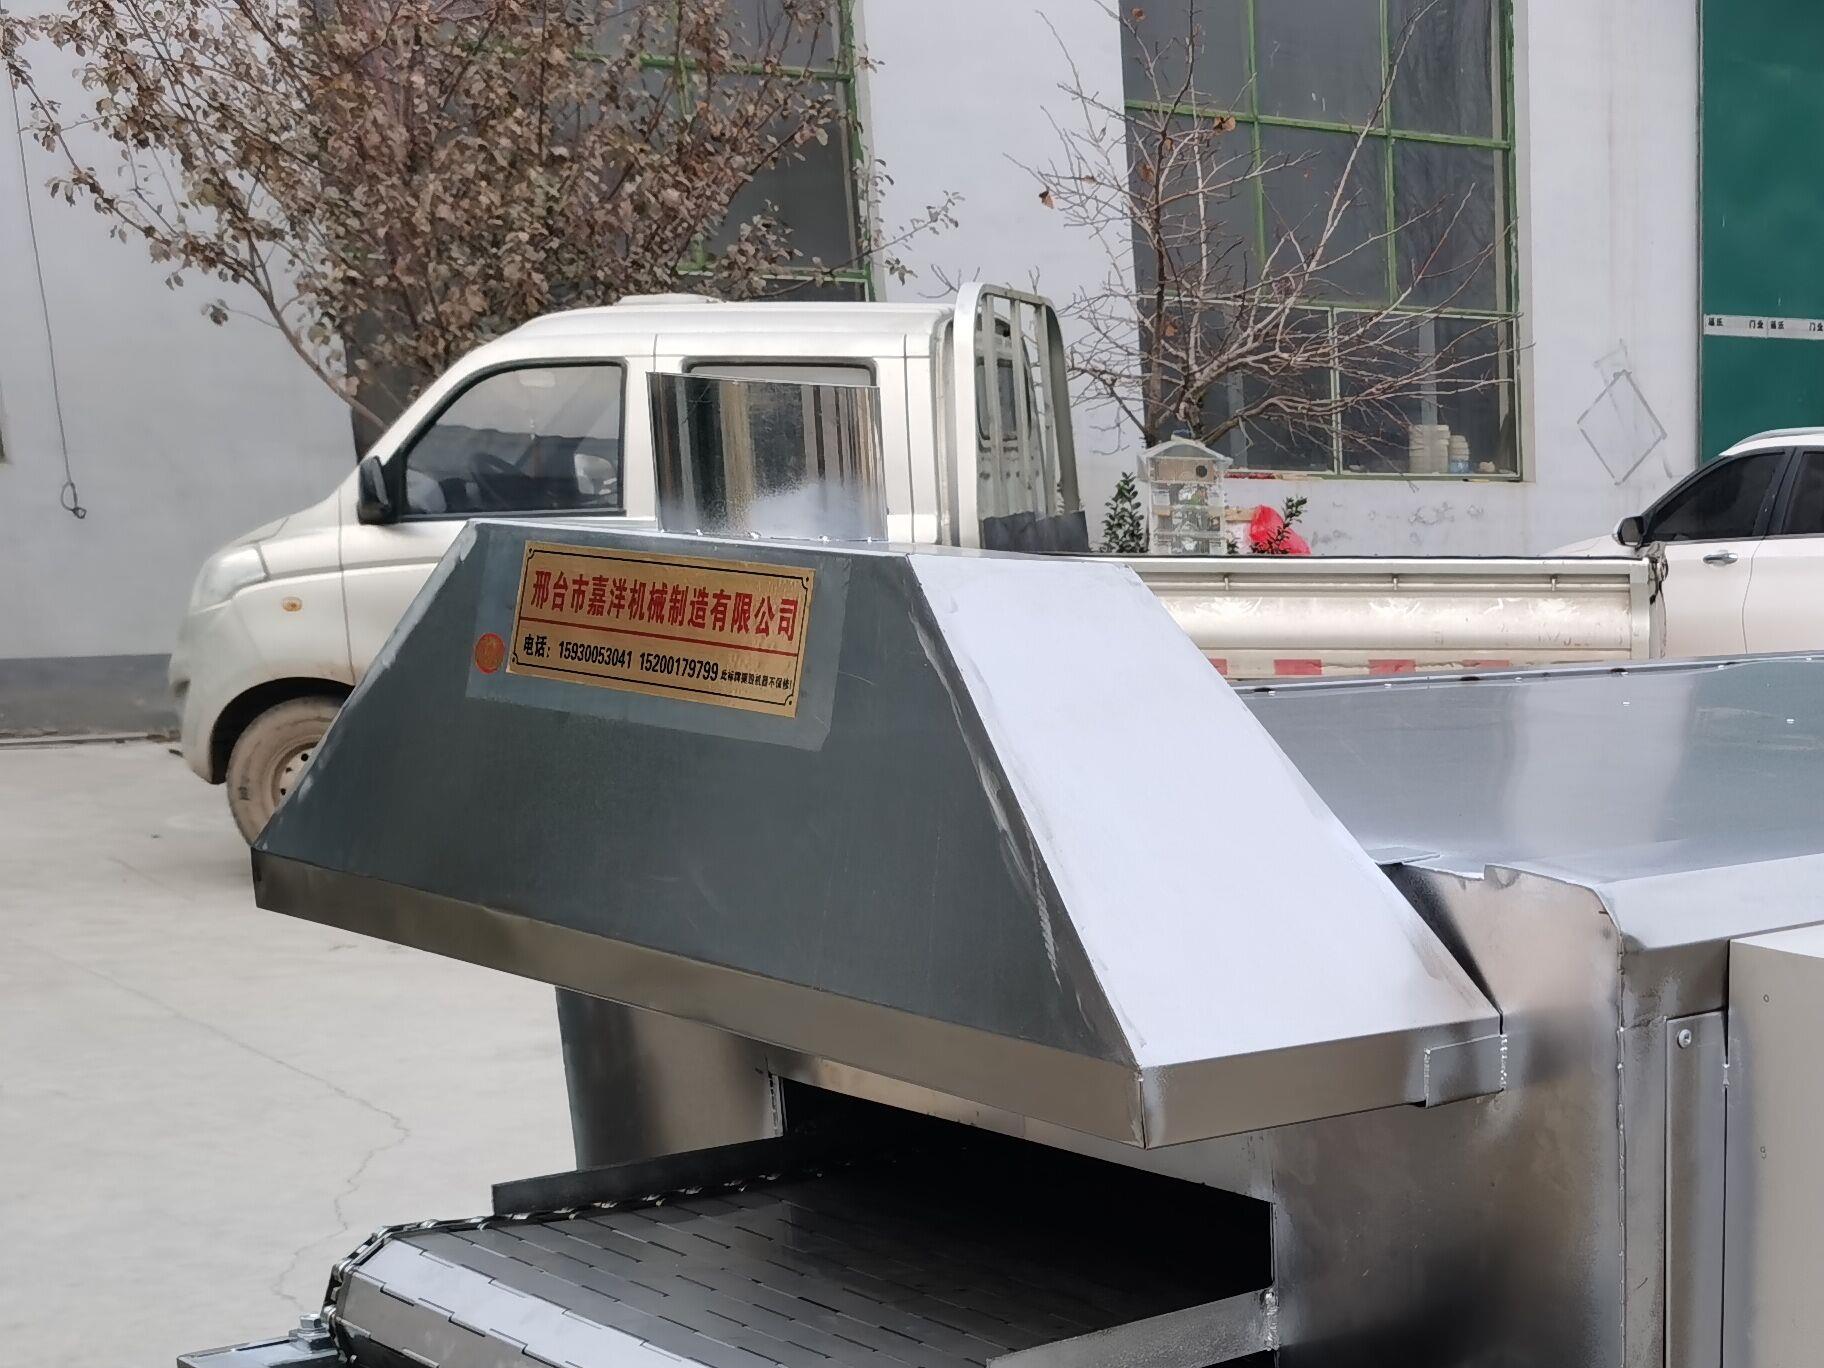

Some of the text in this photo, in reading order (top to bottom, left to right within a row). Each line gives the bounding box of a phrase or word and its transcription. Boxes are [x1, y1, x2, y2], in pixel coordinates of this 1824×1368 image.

[531, 569, 799, 642] 邢台市嘉洋机械制造有限公司
[558, 641, 633, 670] 15930053041
[639, 652, 719, 682] 15200179799
